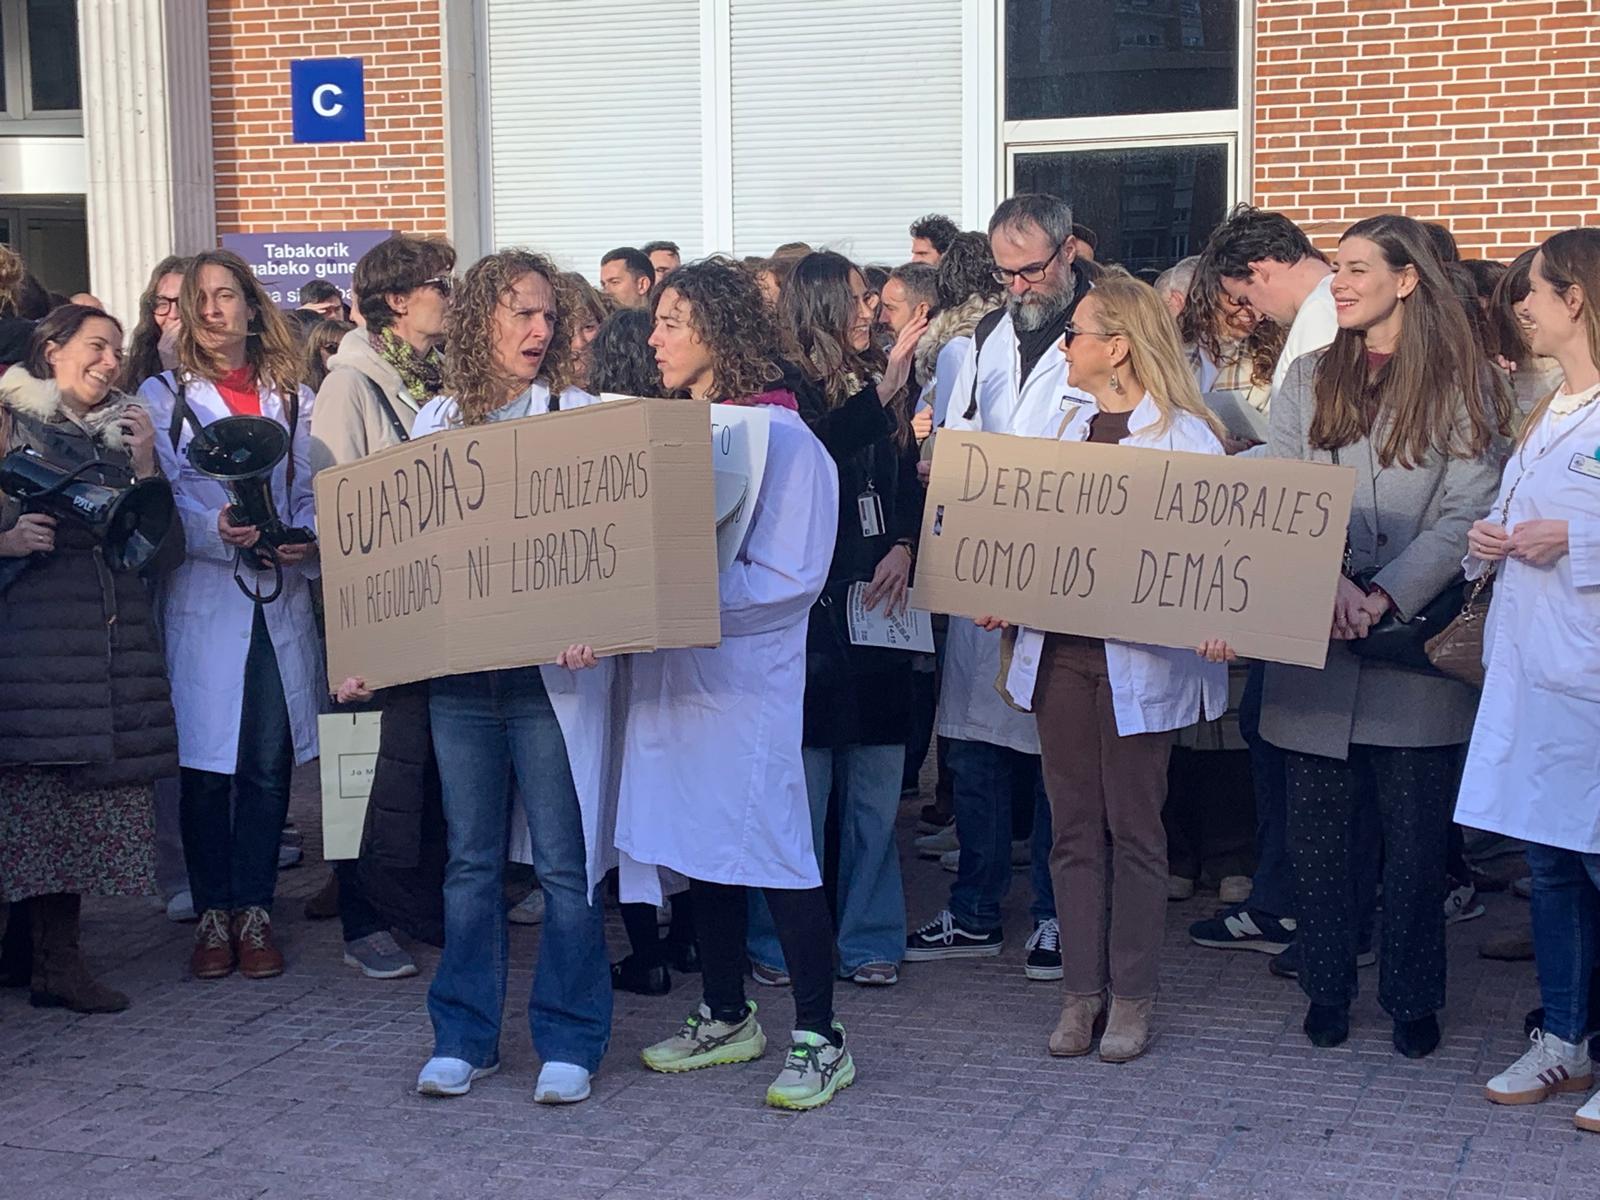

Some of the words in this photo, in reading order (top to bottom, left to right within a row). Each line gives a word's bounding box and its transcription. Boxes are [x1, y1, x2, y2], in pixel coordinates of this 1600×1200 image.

[312, 83, 344, 117] C
[264, 242, 349, 259] Tabakorik
[287, 287, 301, 303] si
[957, 442, 1130, 516] DERECHOS
[1154, 460, 1332, 538] LABORALES
[366, 554, 442, 624] REGULADAS
[512, 522, 617, 594] LIBRADAS
[954, 536, 1036, 592] COMO
[1050, 545, 1097, 598] LOS
[1131, 539, 1252, 613] DEMÁS
